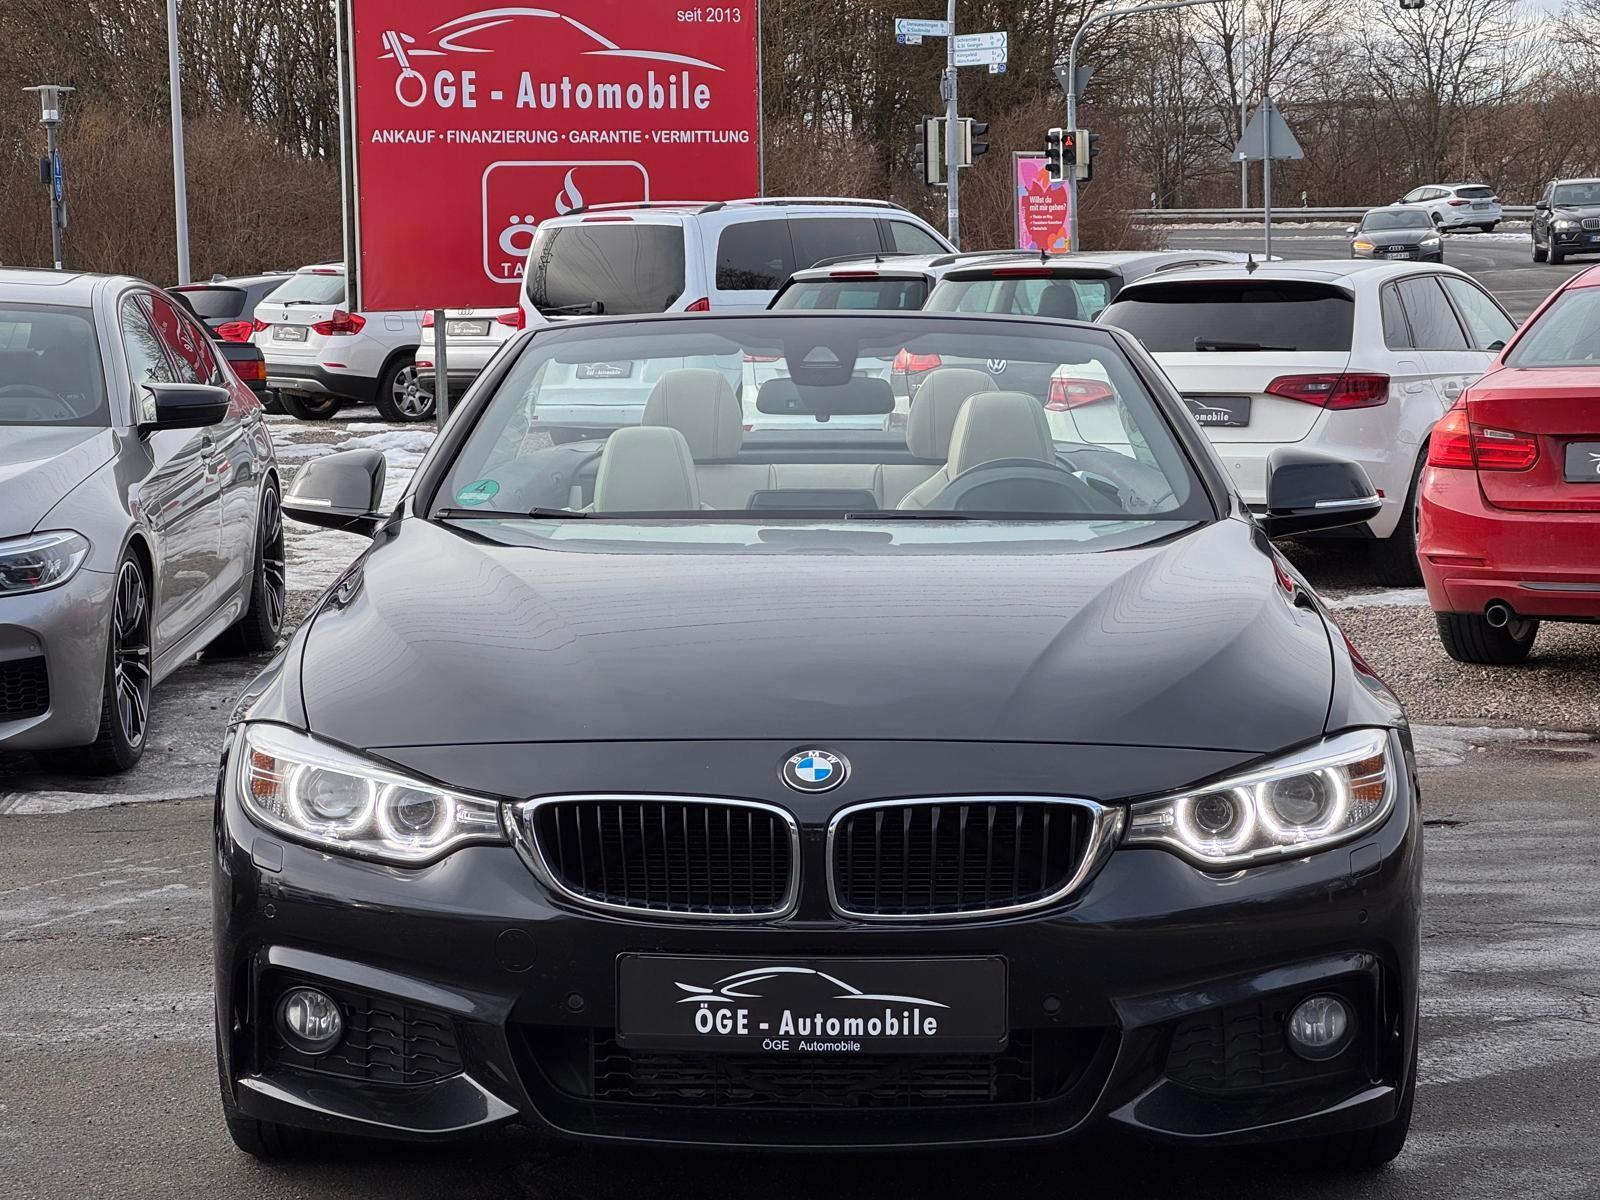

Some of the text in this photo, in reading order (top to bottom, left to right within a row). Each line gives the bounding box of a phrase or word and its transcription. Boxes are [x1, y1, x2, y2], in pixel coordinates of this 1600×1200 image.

[676, 7, 741, 24] seit 2013
[516, 70, 711, 110] Automobile
[371, 129, 750, 144] ANKAUF FINANZIERUNG GARANTIE VERMITTLUNG
[789, 751, 838, 764] BMW
[694, 1002, 749, 1036] ÖGE
[778, 1007, 938, 1037] Automobile
[762, 1038, 861, 1052] ÖGE Automobile
